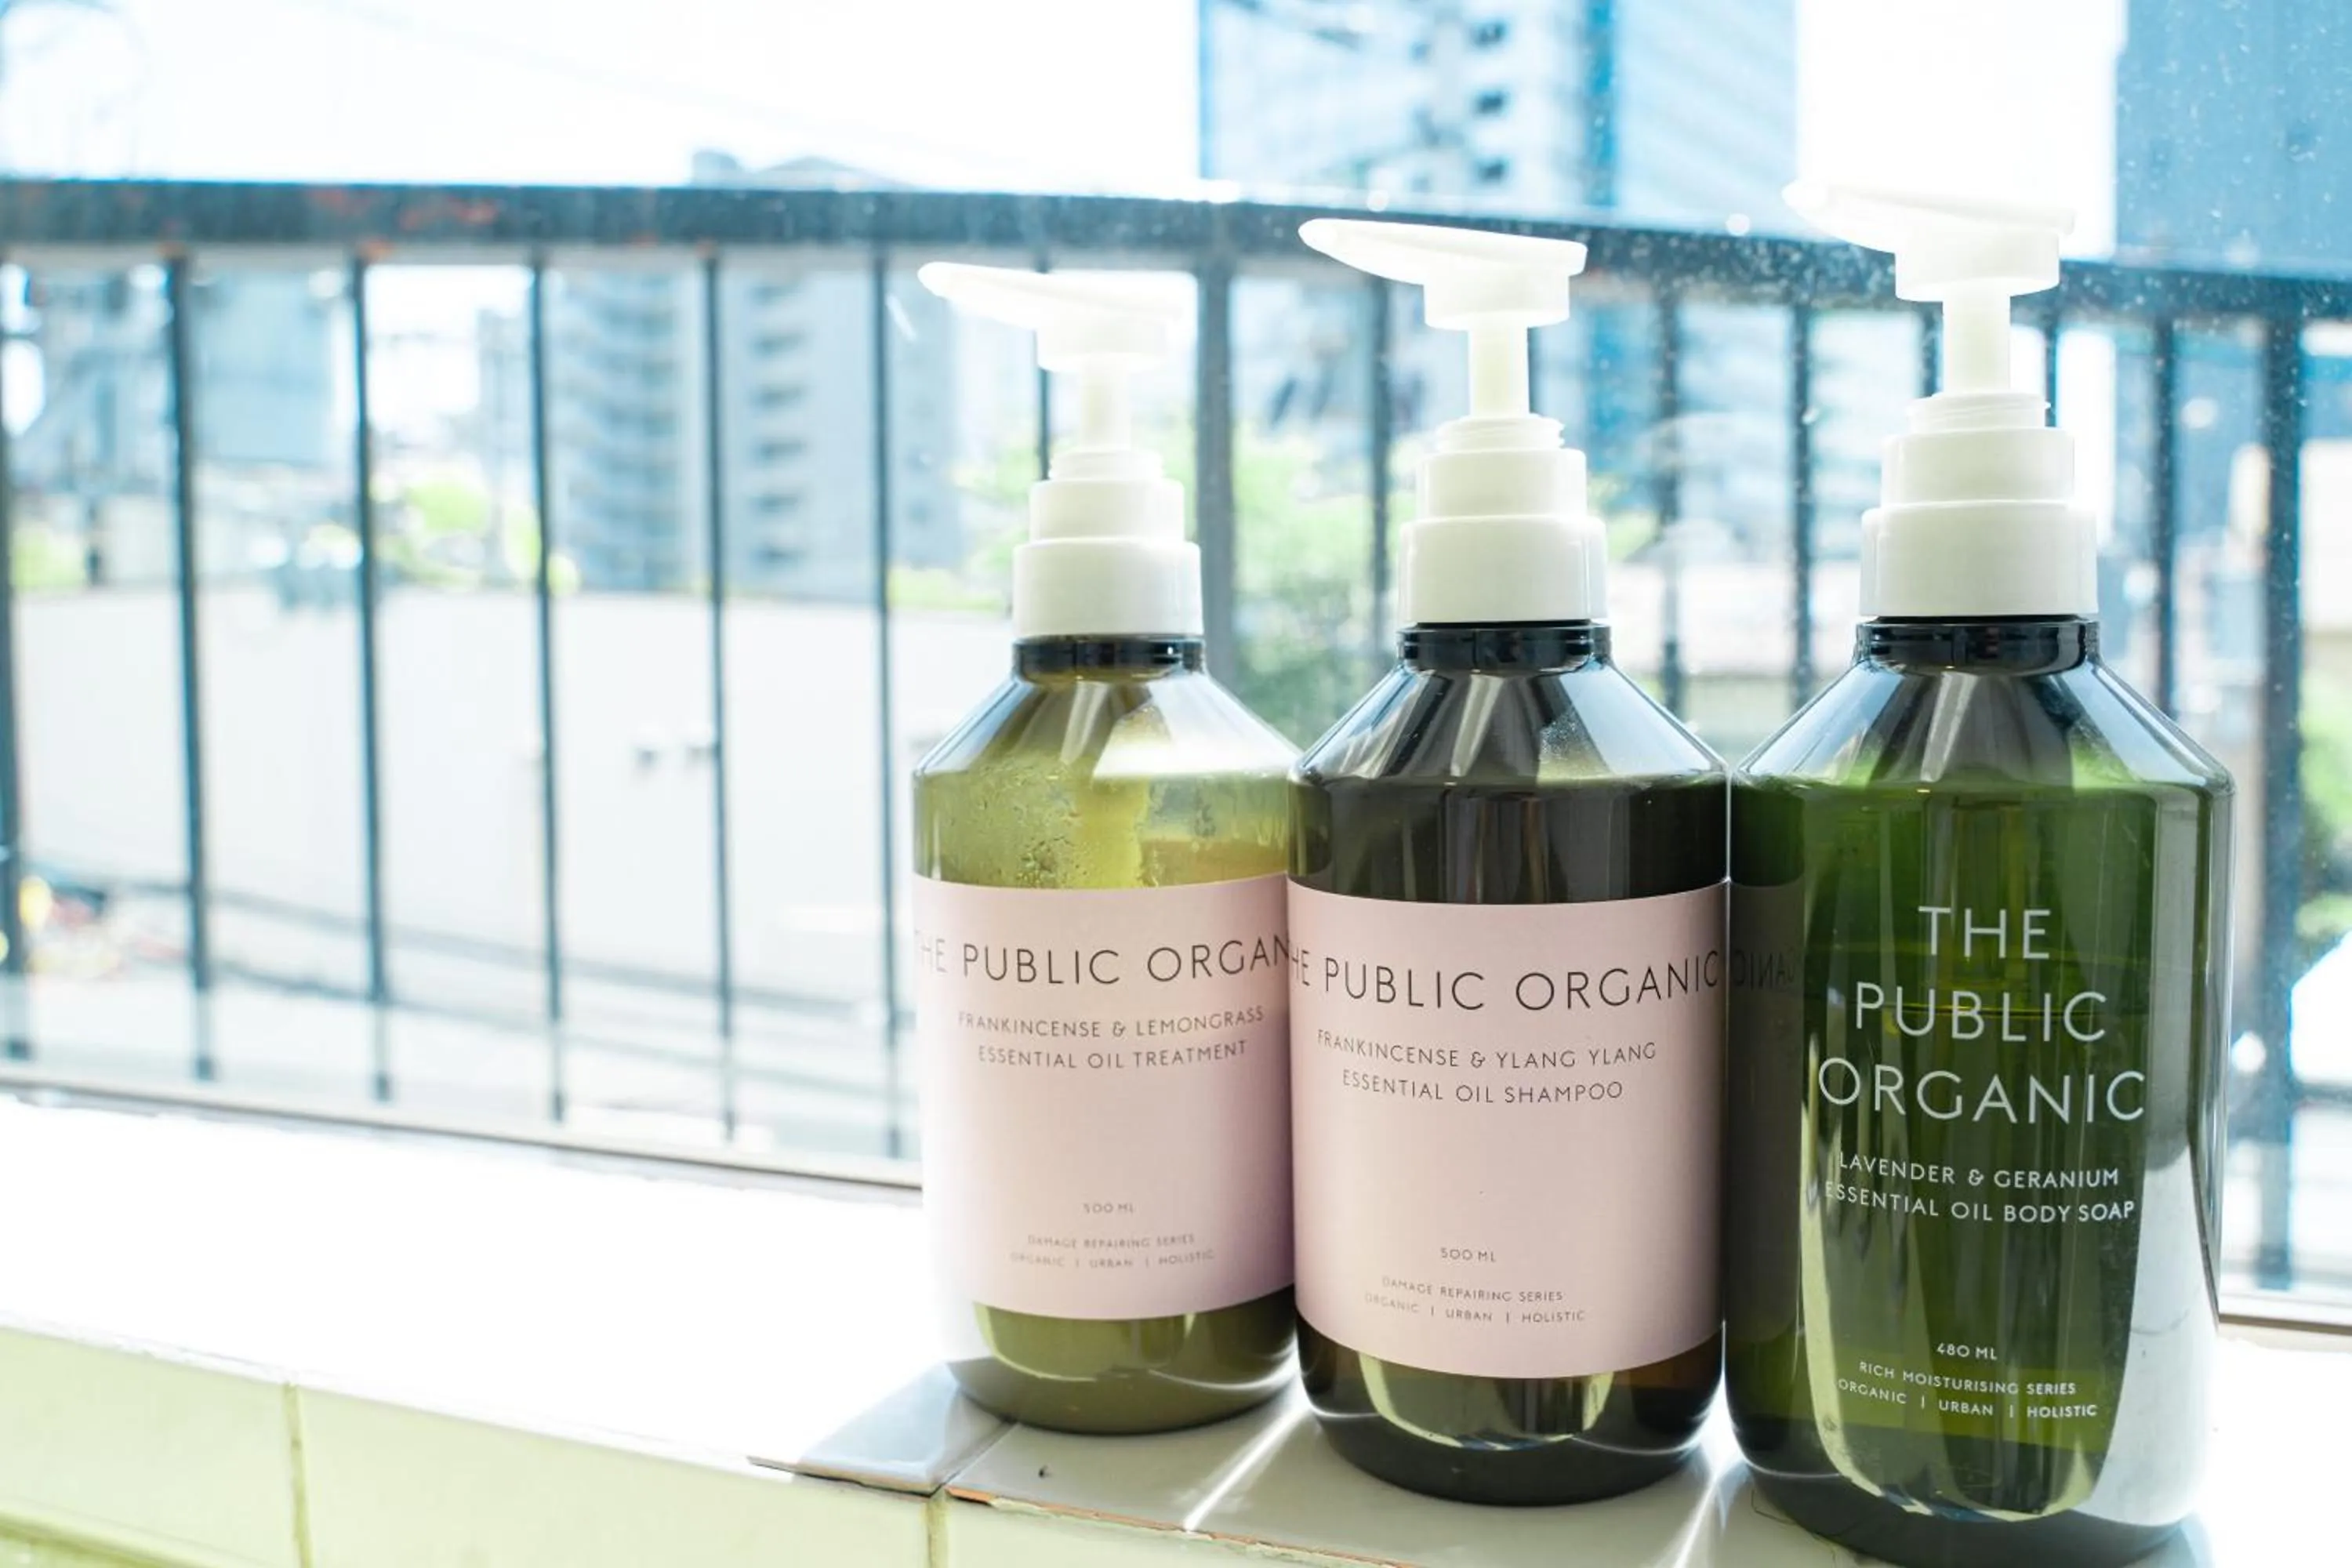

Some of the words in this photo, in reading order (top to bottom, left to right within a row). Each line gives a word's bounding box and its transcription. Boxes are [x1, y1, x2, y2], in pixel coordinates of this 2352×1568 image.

[1918, 905, 2053, 960] THE
[963, 942, 1120, 985] PUBLIC
[1147, 935, 1289, 982] ORGAN
[1325, 955, 1485, 1011] PUBLIC
[1515, 947, 1719, 1012] ORGANIC
[958, 1009, 1100, 1038] FRANKINCENSE
[1112, 1021, 1125, 1038] &
[1136, 1006, 1264, 1037] LEMONGRASS
[1854, 980, 2107, 1043] PUBLIC
[979, 1044, 1076, 1069] ESSENTIAL
[1088, 1052, 1123, 1069] OIL
[1134, 1040, 1247, 1068] TREATMENT
[1316, 1026, 1459, 1069] FRANKINCENSE
[1471, 1049, 1486, 1069] &
[1496, 1047, 1577, 1069] YLANG
[1588, 1040, 1657, 1068] YLANG
[1341, 1066, 1443, 1101] ESSENTIAL
[1454, 1082, 1494, 1105] OIL
[1504, 1079, 1624, 1105] SHAMPOO
[1817, 1057, 2147, 1123] ORGANIC
[1839, 1151, 1955, 1184] LAVENDER
[1968, 1168, 1984, 1186] &
[1994, 1168, 2118, 1189] GERANIUM
[1824, 1181, 1939, 1216] ESSENTIAL
[1951, 1201, 1992, 1221] OIL
[2004, 1204, 2071, 1223] BODY
[2078, 1200, 2135, 1222] SOAP
[1440, 1247, 1472, 1261] 500
[1478, 1250, 1496, 1263] ML
[1364, 1291, 1420, 1312] ORGANIC
[1445, 1309, 1492, 1322] URBAN
[1521, 1309, 1585, 1323] HOLISTIC
[1381, 1276, 1433, 1295] DAMAGE
[1439, 1286, 1511, 1302] REPAIRING
[1518, 1290, 1564, 1303] SERIES
[1936, 1341, 1969, 1357] 480
[1976, 1347, 1997, 1360] ML
[1838, 1377, 1907, 1405] ORGANIC
[1939, 1399, 1993, 1416] URBAN
[2027, 1404, 2097, 1418] HOLISTIC
[1860, 1361, 1894, 1378] RICH
[1903, 1370, 2018, 1394] MOISTURISING
[2027, 1382, 2077, 1396] SERIES
